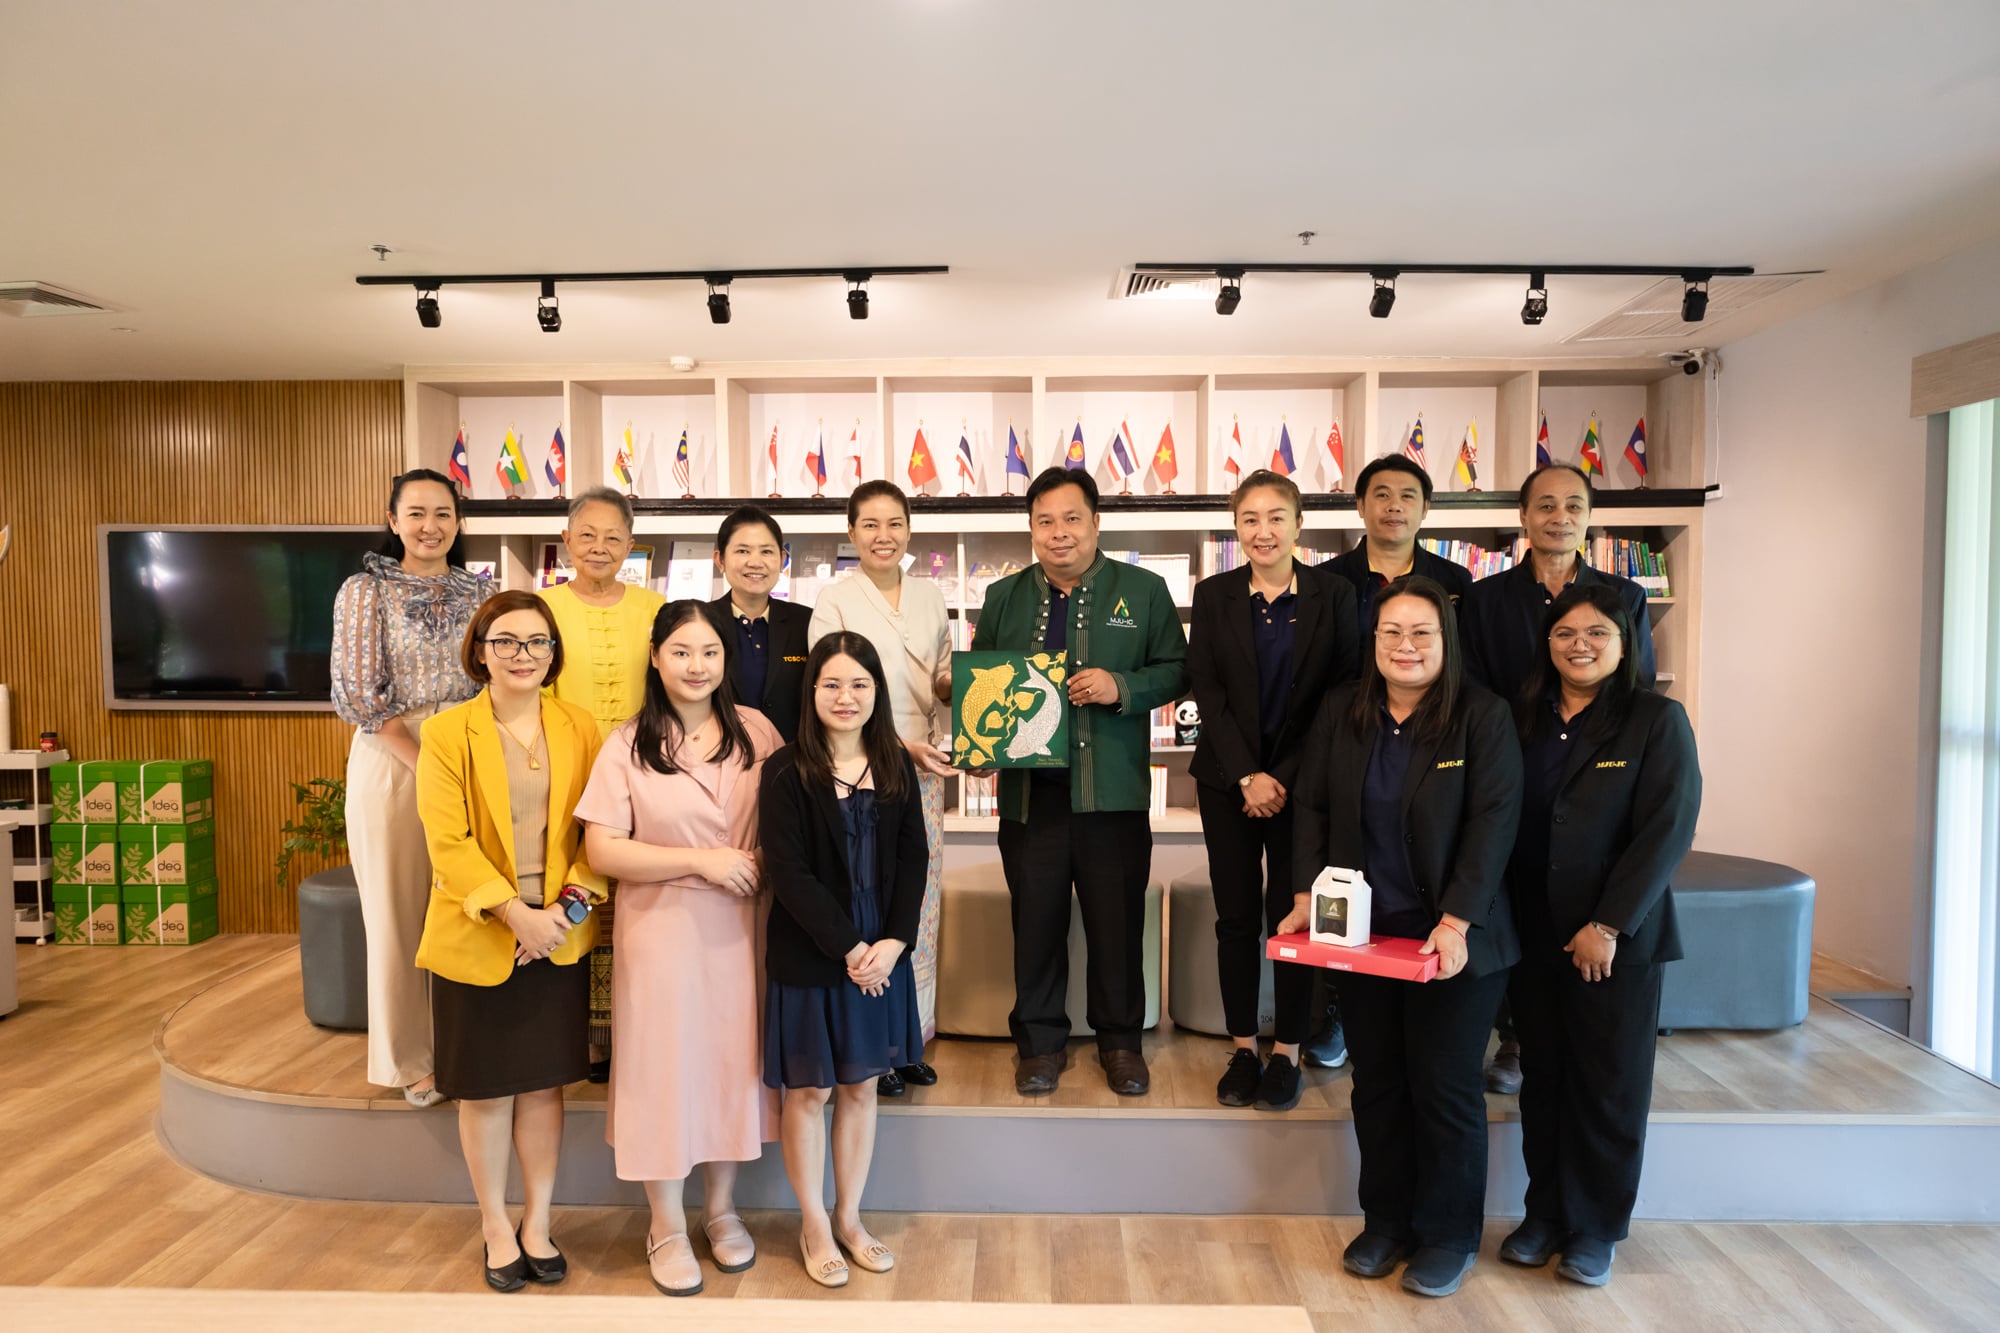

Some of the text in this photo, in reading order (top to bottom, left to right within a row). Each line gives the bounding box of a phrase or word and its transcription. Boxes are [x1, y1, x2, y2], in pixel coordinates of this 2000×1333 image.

[155, 859, 181, 871] dea
[88, 919, 115, 932] dea
[160, 919, 185, 932] dea
